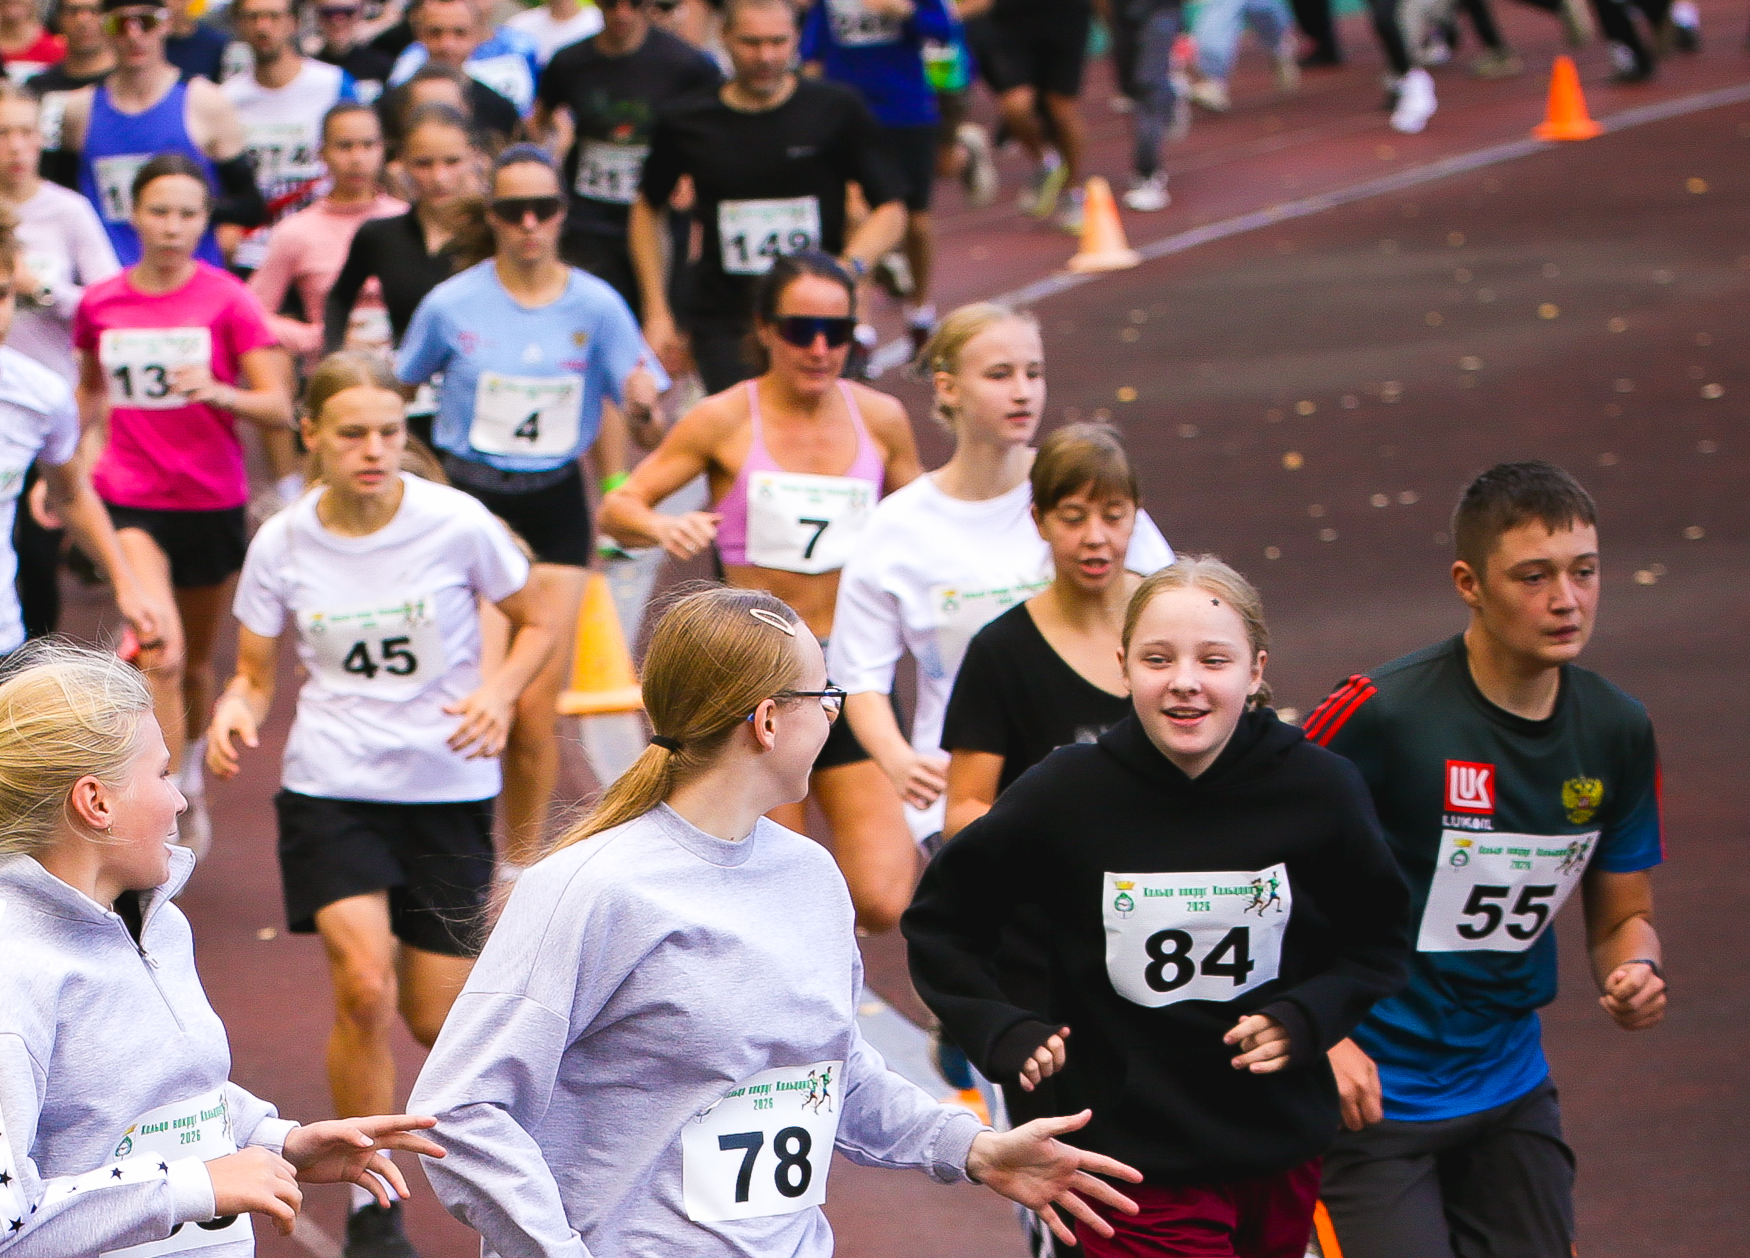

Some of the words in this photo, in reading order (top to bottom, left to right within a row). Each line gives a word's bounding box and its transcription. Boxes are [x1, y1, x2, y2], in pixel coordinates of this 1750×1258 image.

[512, 411, 540, 442] 4
[797, 517, 830, 559] 7
[342, 635, 418, 679] 45
[1441, 814, 1496, 831] LUKOIL
[1456, 884, 1558, 940] 55
[1144, 926, 1255, 993] 84
[753, 1097, 774, 1111] 2026
[140, 1120, 169, 1136] Кольцо
[172, 1115, 197, 1130] вокруг
[180, 1129, 201, 1145] 2026
[717, 1126, 813, 1203] 78
